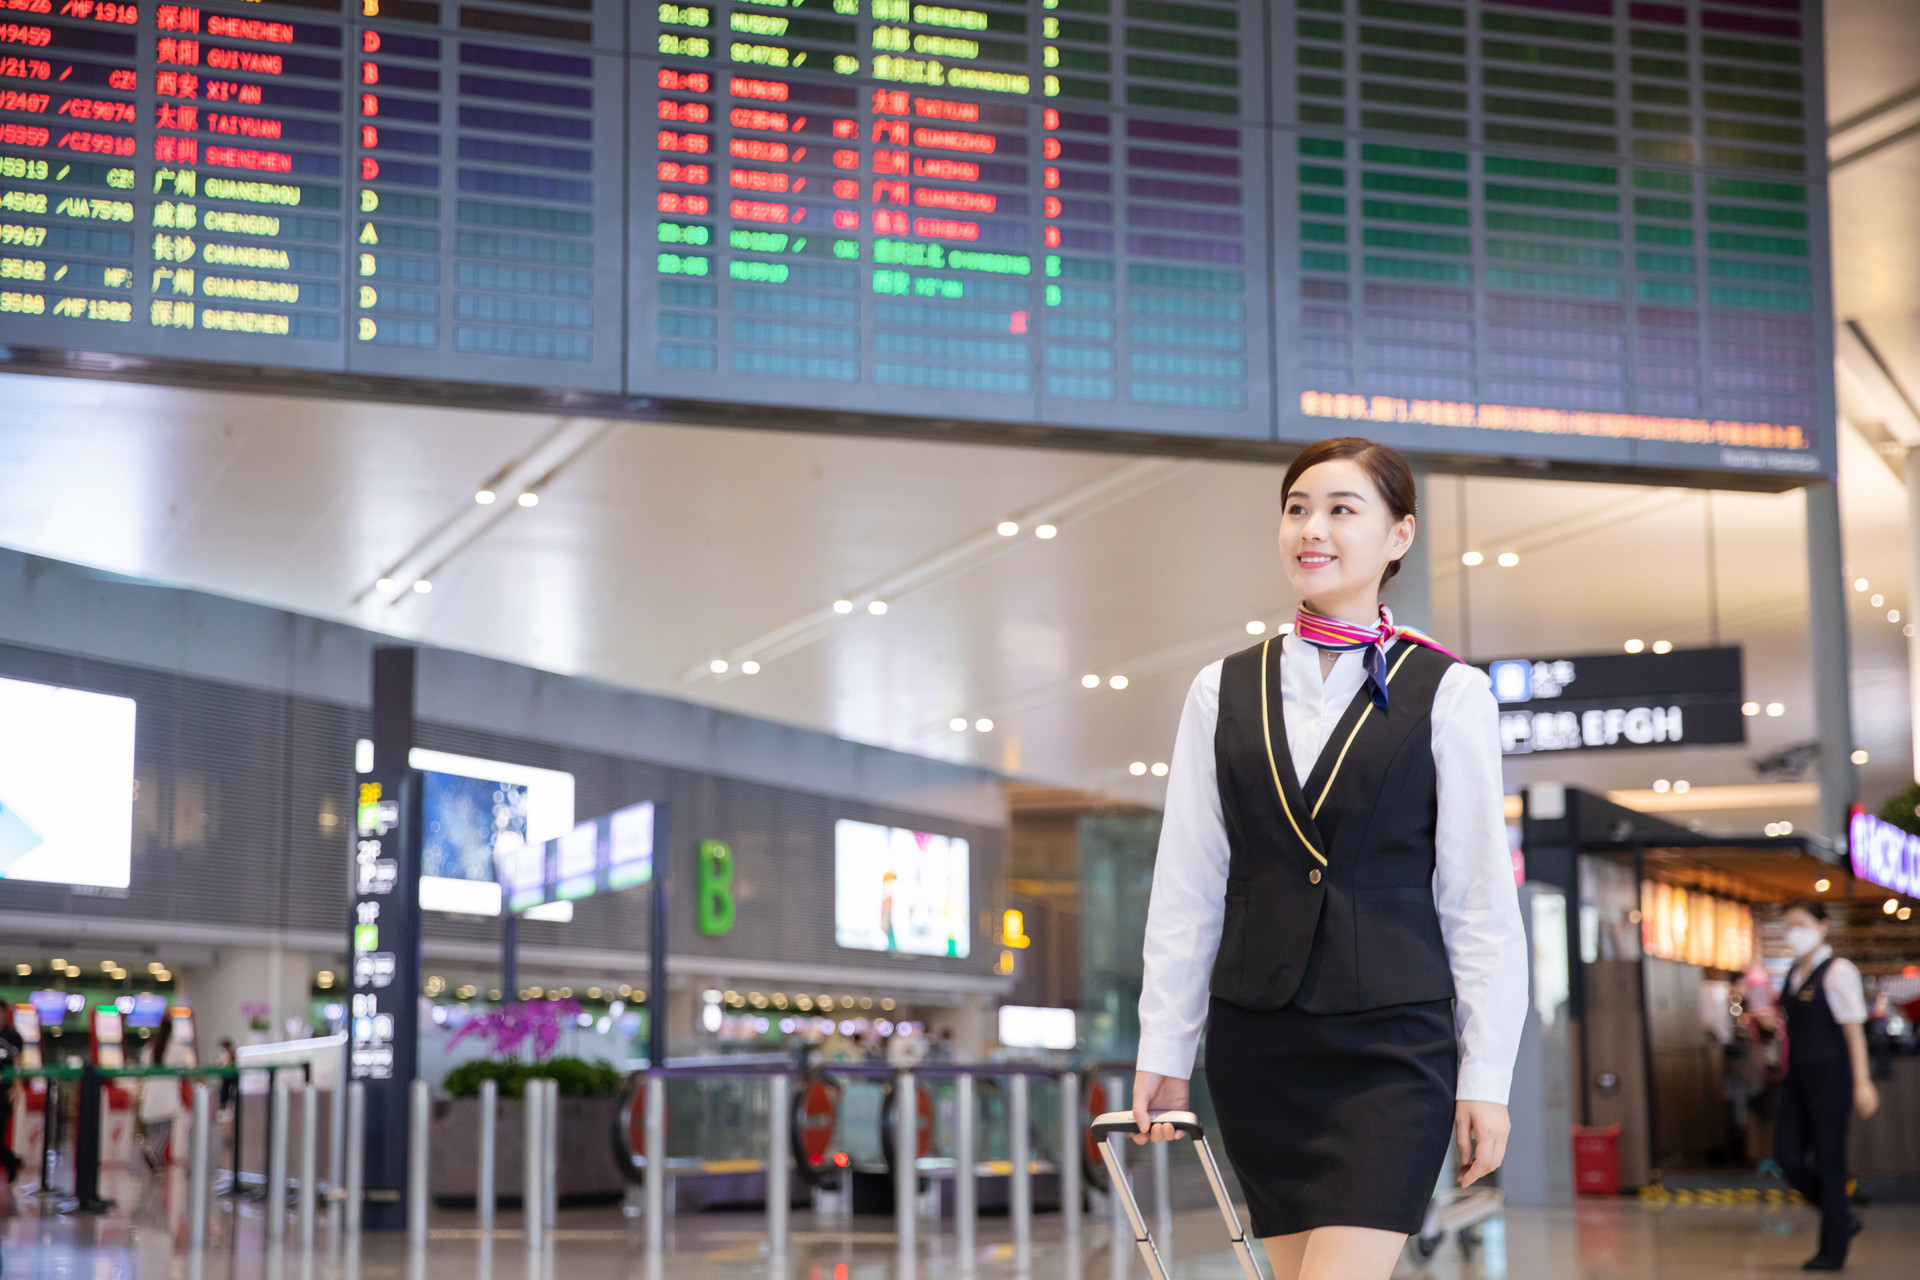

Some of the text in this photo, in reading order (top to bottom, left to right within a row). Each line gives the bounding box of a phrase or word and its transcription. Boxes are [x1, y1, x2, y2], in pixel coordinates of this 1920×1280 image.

[157, 4, 200, 34] 深圳
[208, 16, 293, 43] SHENZHEN
[363, 31, 380, 52] D
[207, 48, 282, 74] GUIYANG
[156, 71, 198, 99] 西安
[155, 103, 198, 131] 太原
[207, 113, 281, 139] TAIYUAN
[154, 135, 197, 165] 深圳
[205, 146, 291, 173] SHENZHEN
[362, 158, 379, 180] D
[913, 128, 996, 154] GUANGZHOU
[0, 157, 48, 180] 5313
[154, 168, 196, 197] 广州
[204, 178, 300, 205] GUANGZHOU
[361, 190, 378, 212] D
[913, 187, 996, 213] GUANGZHOU
[204, 211, 279, 236] CHENGDU
[360, 223, 378, 244] A
[0, 225, 46, 246] 9967
[204, 244, 289, 269] CHANGSHA
[153, 267, 194, 296] 广州
[203, 277, 298, 302] GUANGZHOU
[360, 287, 376, 307] D
[203, 310, 288, 334] SHENZHEN
[361, 319, 376, 340] D
[1582, 706, 1683, 746] EFGH
[699, 839, 735, 936] B
